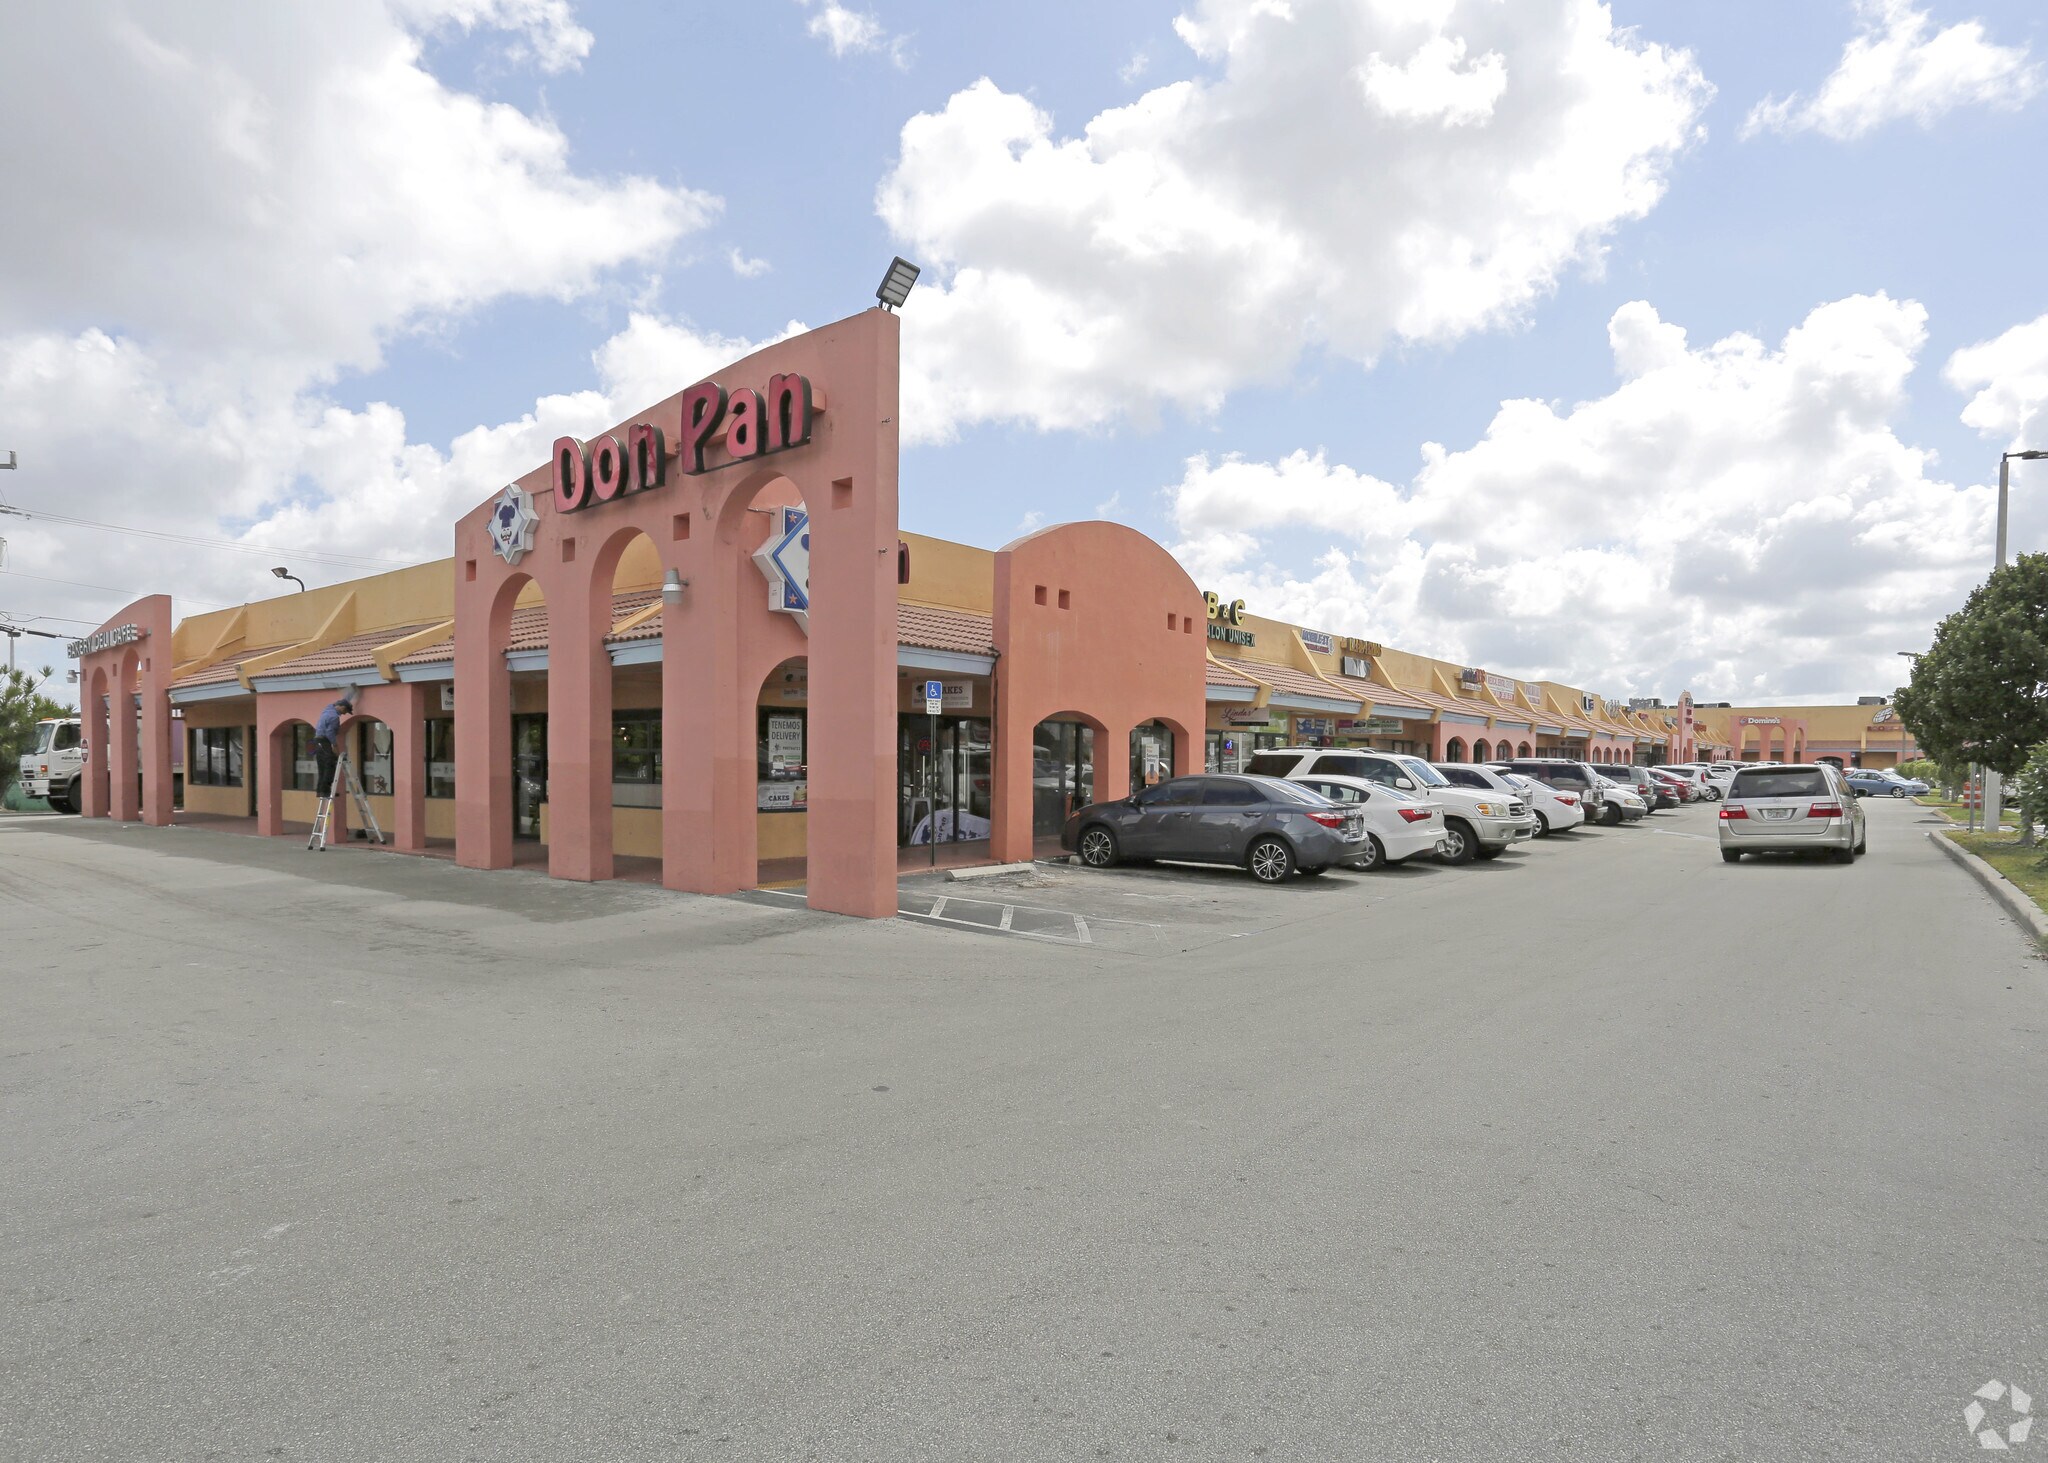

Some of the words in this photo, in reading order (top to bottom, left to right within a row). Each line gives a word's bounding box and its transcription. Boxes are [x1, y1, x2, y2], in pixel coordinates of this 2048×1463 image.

[553, 424, 665, 513] Don
[681, 373, 812, 475] Pan
[67, 636, 94, 658] BAKERY
[95, 630, 112, 650] DELI
[113, 624, 138, 647] CAFE
[1207, 625, 1226, 641] ALON
[1229, 629, 1255, 647] UNISEX
[942, 686, 963, 694] AKES
[771, 720, 800, 730] TENEMOS
[771, 732, 800, 740] DELIVERY
